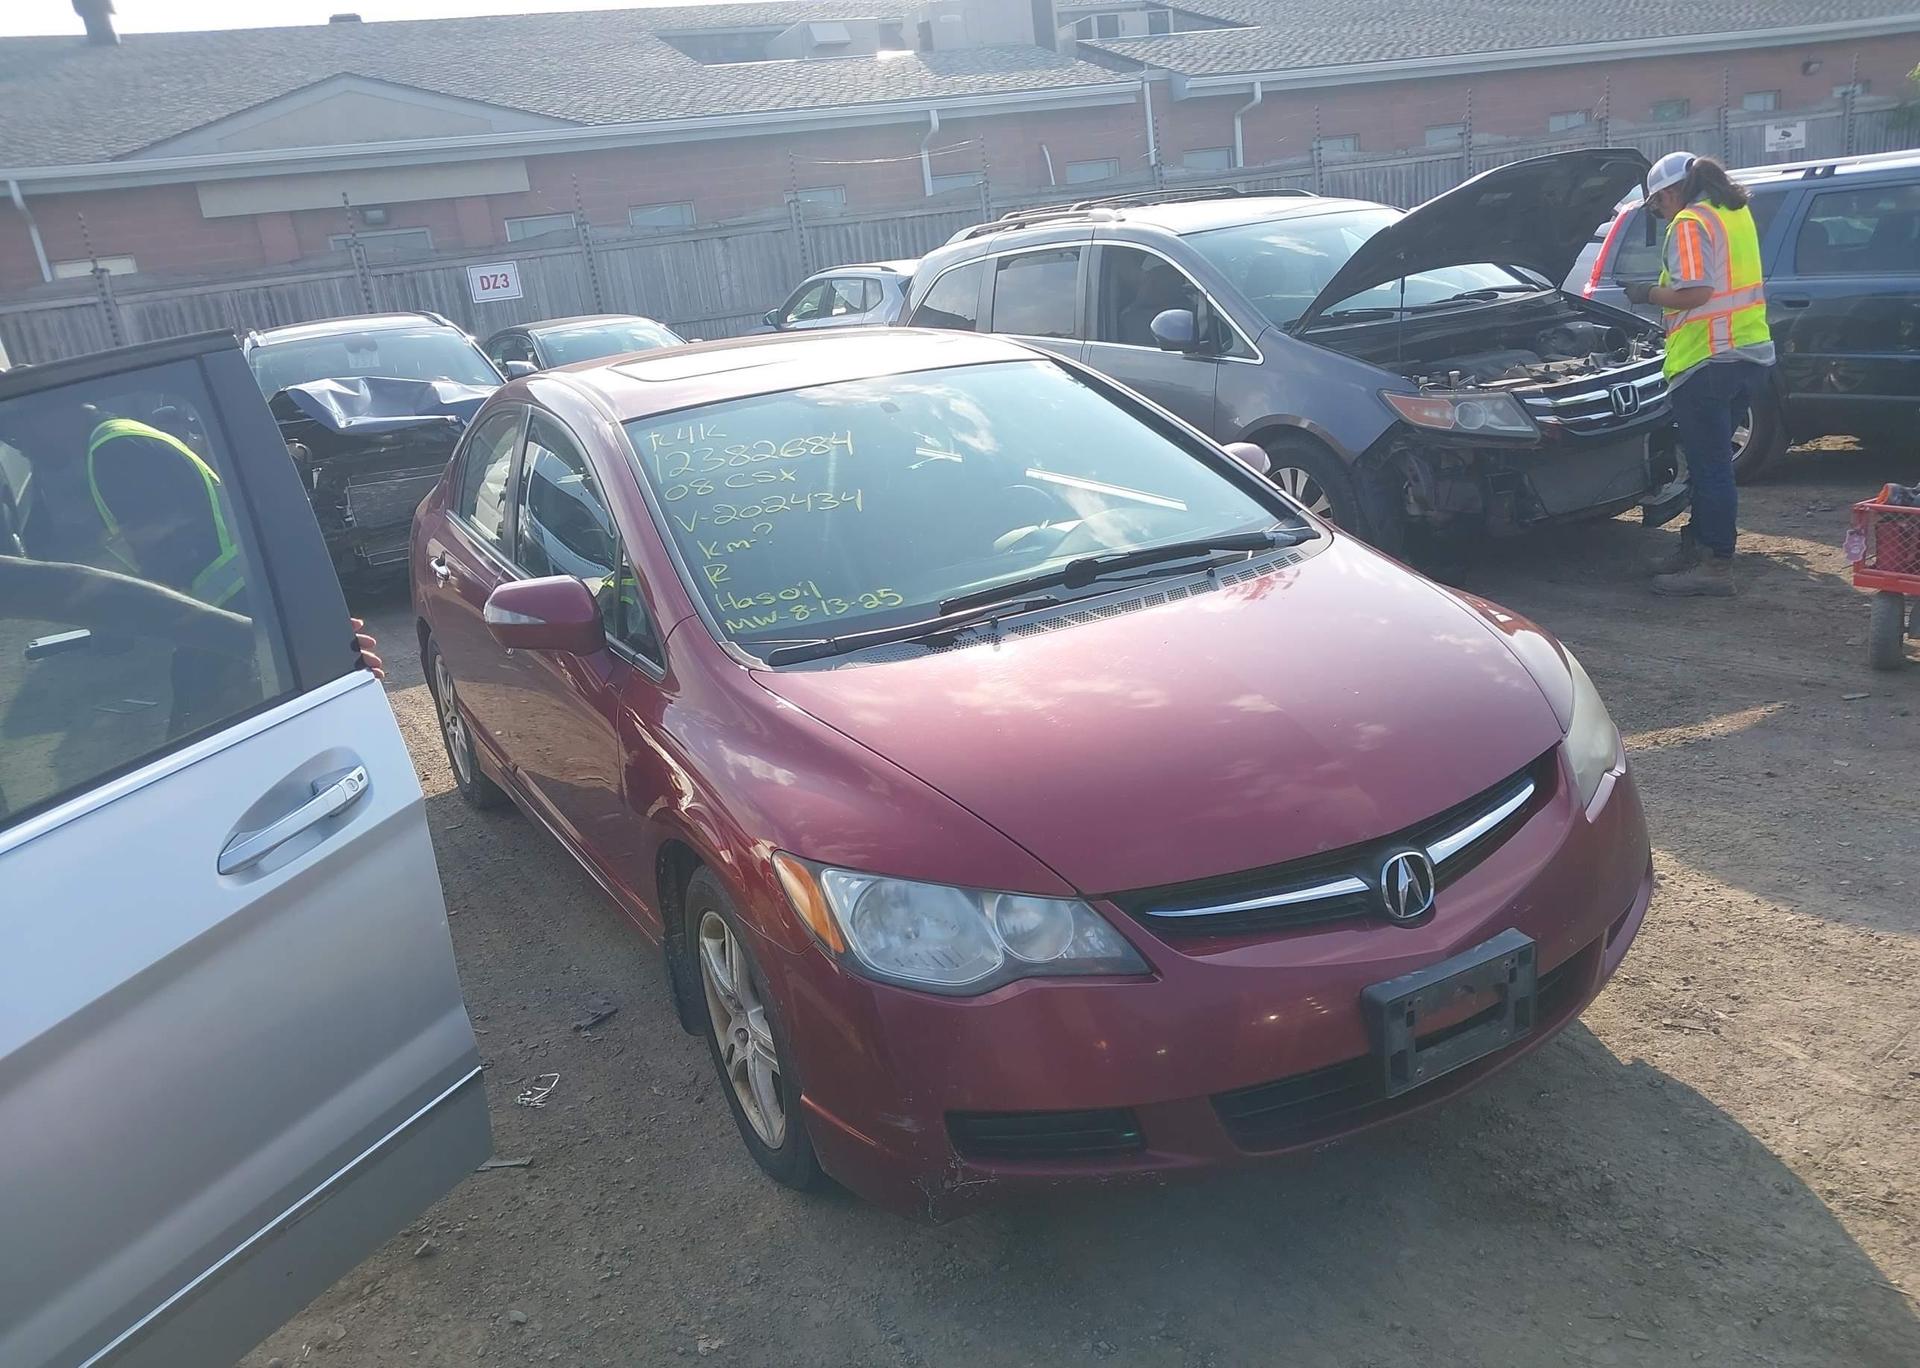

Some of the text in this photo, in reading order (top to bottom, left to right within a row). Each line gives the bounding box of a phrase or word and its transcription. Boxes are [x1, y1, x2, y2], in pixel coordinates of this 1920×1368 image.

[480, 273, 510, 291] DZ3
[654, 430, 854, 484] 12382684
[664, 468, 797, 501] 08 CSX
[703, 563, 731, 589] R
